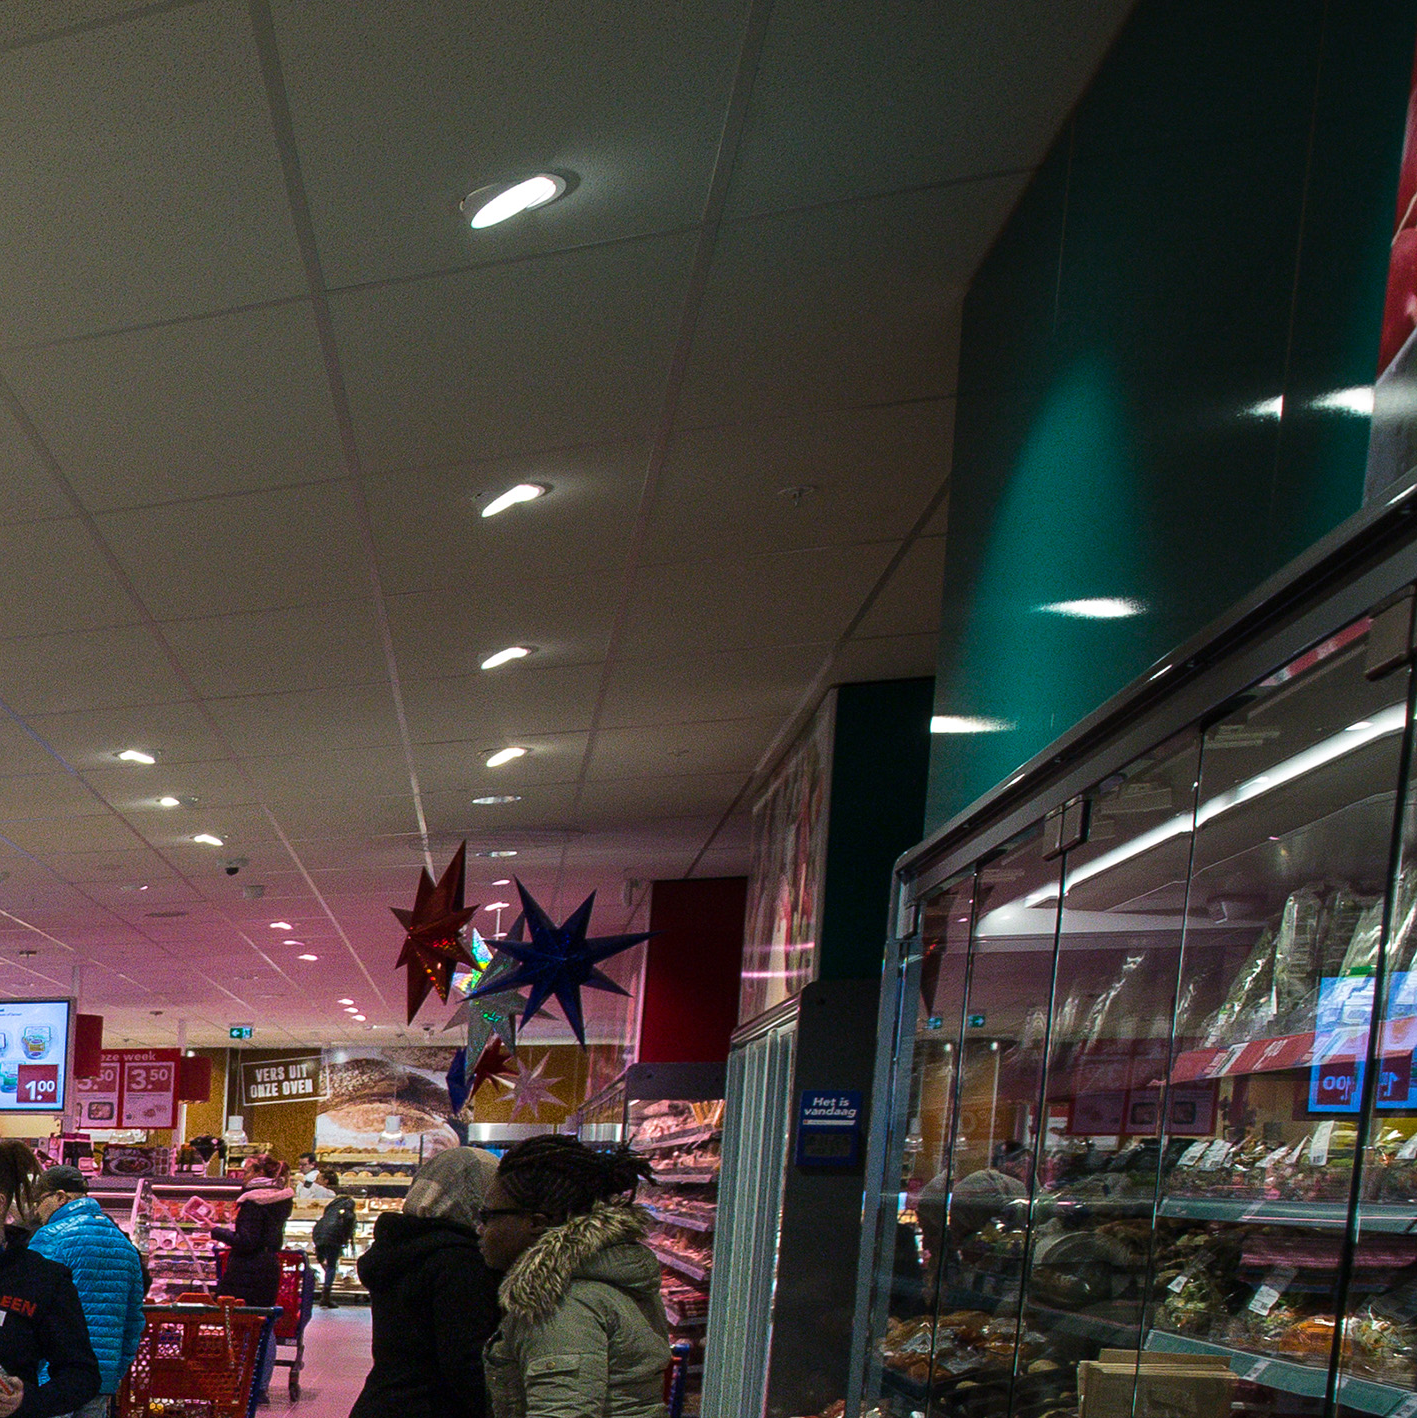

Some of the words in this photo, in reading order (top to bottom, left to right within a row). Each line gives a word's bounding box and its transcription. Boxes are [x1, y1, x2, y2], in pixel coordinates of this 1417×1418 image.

[101, 1052, 119, 1061] eze
[123, 1050, 156, 1061] week
[131, 1069, 168, 1090] 3.50
[256, 1067, 284, 1082] VERS
[289, 1064, 307, 1079] UIT
[25, 1080, 55, 1100] 1.00
[250, 1082, 278, 1098] ONZE
[282, 1079, 313, 1096] OVEN
[813, 1097, 837, 1106] Het
[839, 1097, 850, 1106] is
[804, 1106, 857, 1118] vandaag
